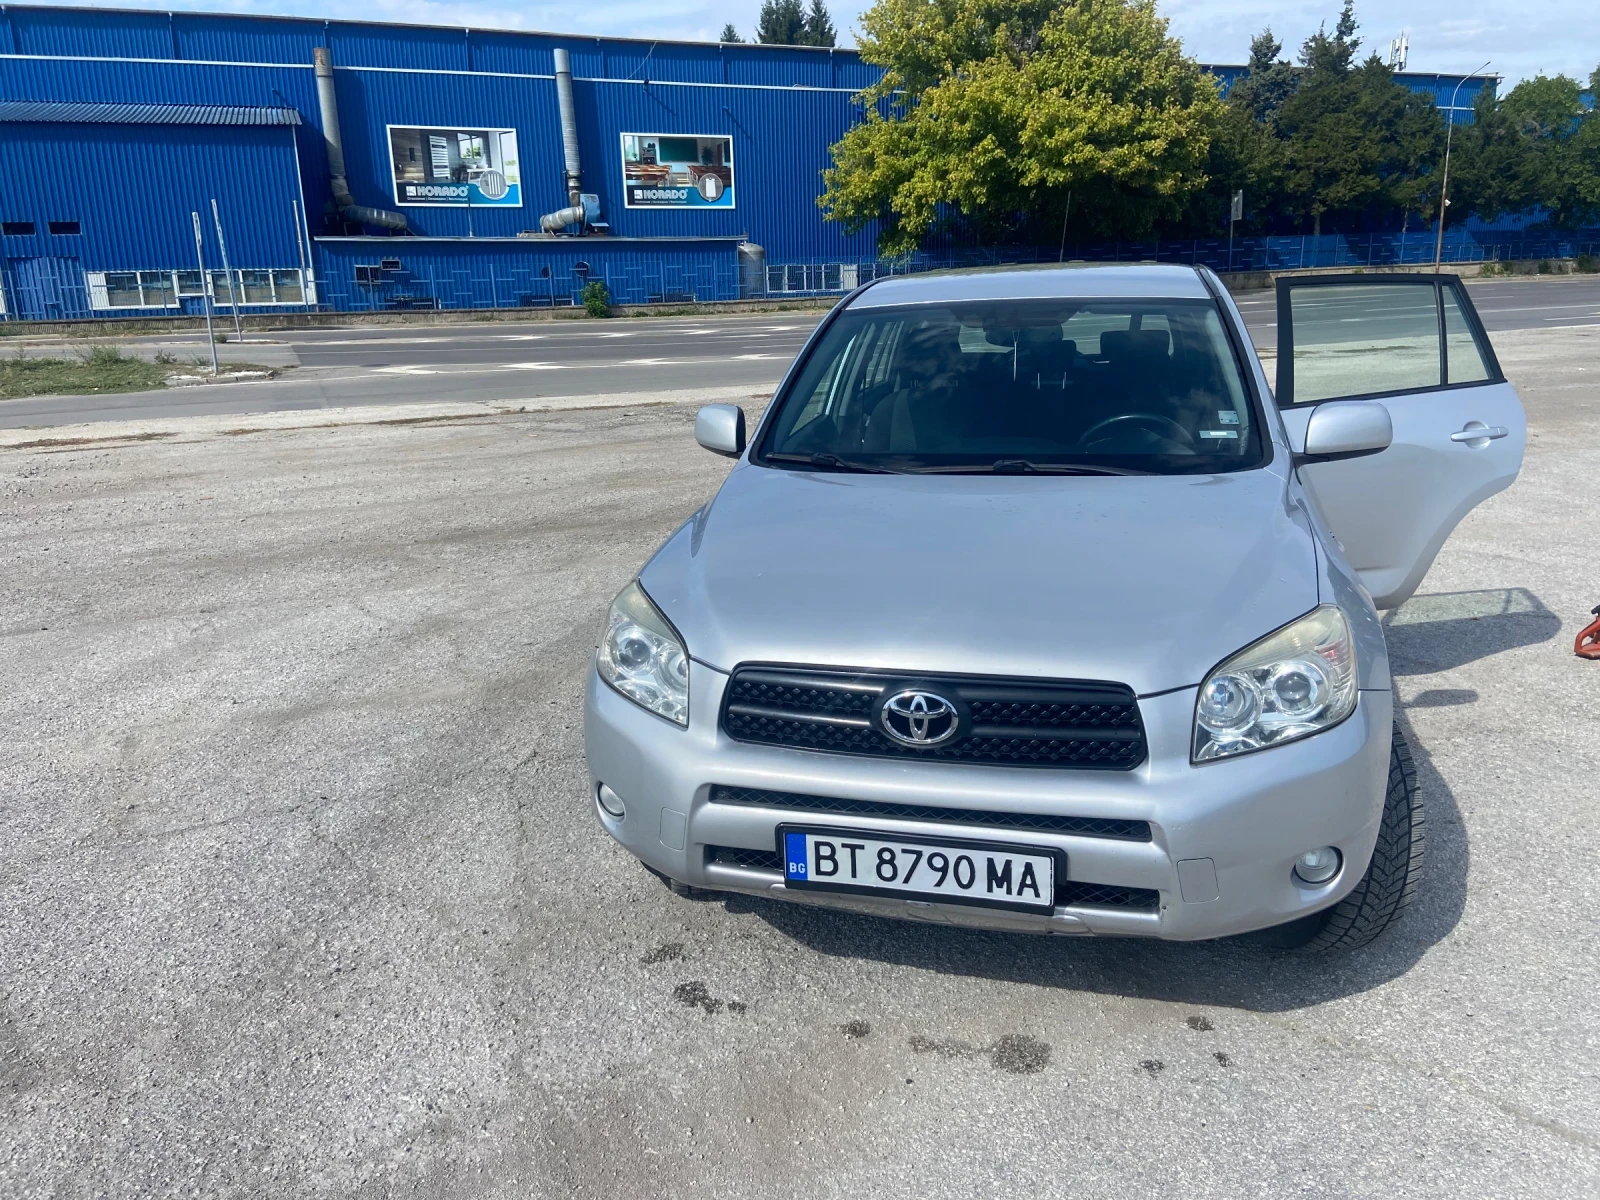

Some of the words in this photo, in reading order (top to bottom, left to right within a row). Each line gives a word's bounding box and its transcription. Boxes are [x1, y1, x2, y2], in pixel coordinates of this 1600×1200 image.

[789, 862, 806, 875] BG
[814, 840, 865, 879] BT
[875, 847, 976, 890] 8790
[986, 857, 1041, 898] MA
